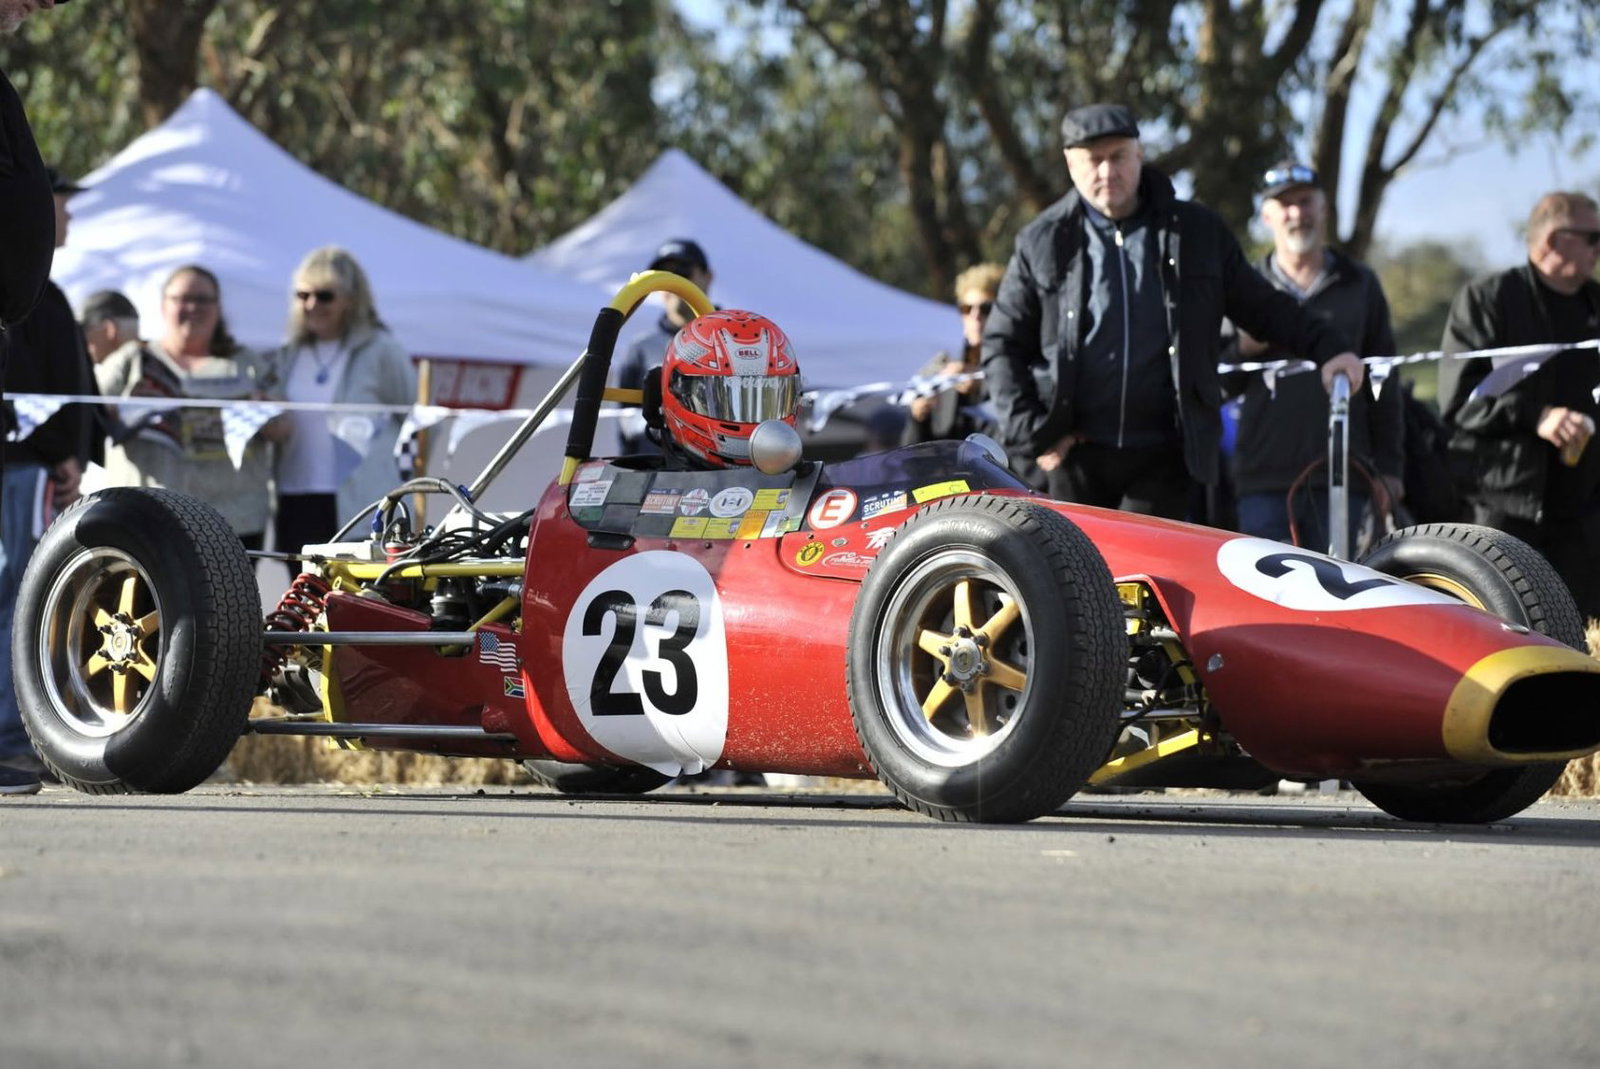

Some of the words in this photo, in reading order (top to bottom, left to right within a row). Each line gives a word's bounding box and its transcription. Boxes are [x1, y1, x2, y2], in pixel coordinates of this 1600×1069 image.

[818, 495, 846, 521] E
[1255, 553, 1399, 600] 2
[582, 589, 700, 716] 23
